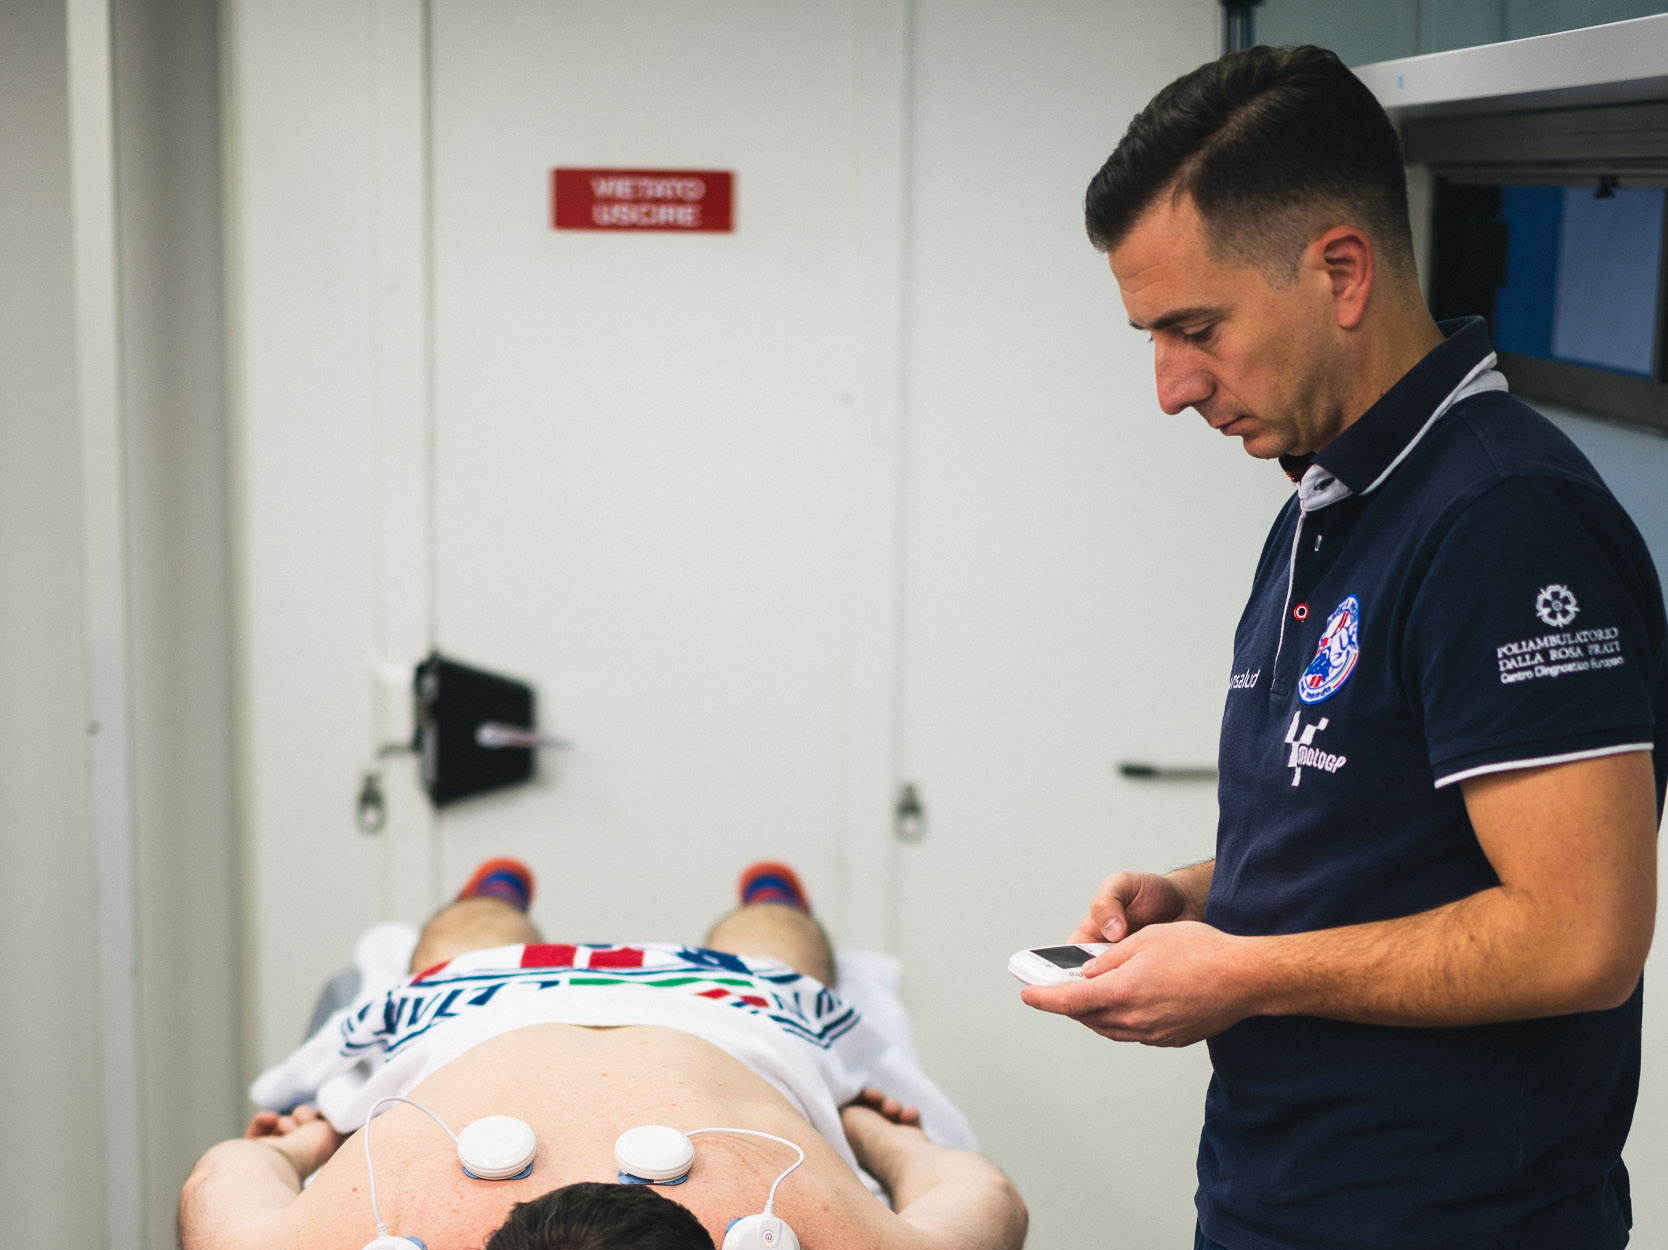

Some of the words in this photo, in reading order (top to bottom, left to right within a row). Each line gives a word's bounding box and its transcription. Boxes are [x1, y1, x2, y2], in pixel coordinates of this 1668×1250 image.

[1497, 627, 1619, 658] POLIAMBULATORIO
[1498, 653, 1544, 671] DALLA
[1549, 647, 1584, 661] ROSA
[1588, 641, 1621, 655] PRATI
[1500, 670, 1534, 684] Centro
